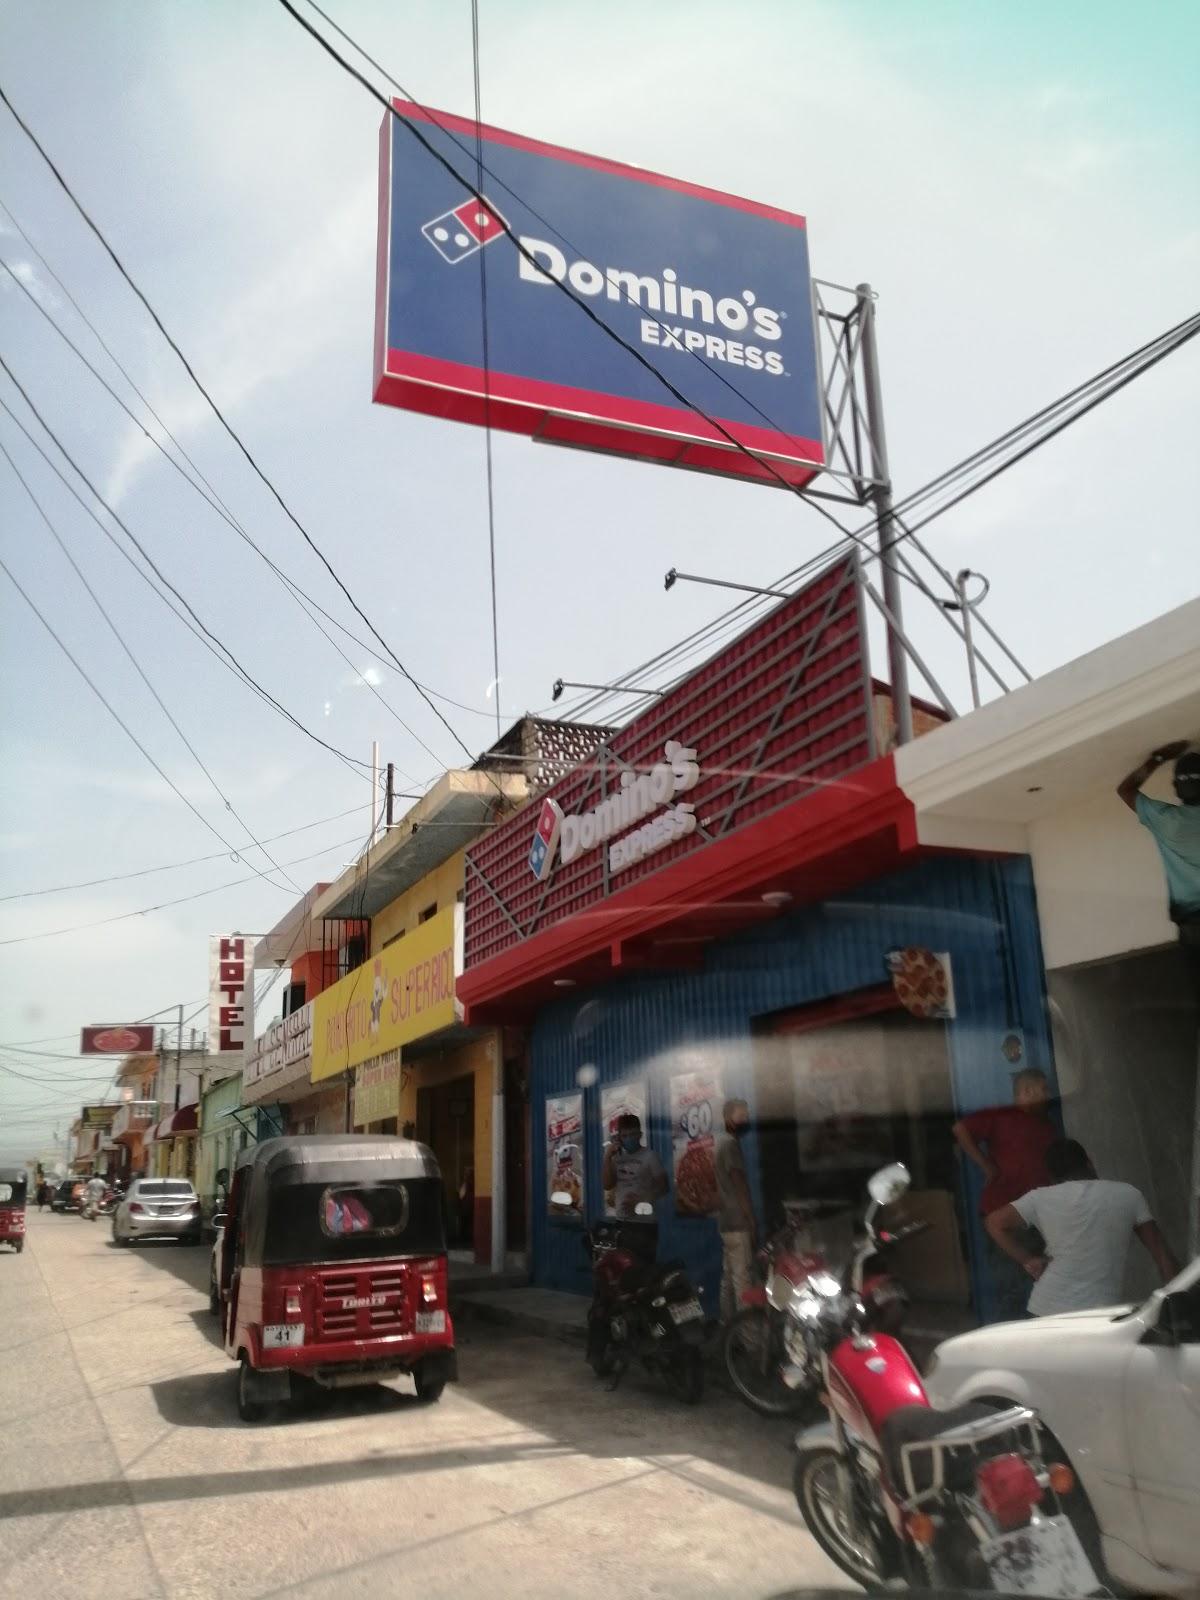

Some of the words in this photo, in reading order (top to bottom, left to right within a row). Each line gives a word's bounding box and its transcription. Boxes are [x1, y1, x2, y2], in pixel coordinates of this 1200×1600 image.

[519, 235, 782, 340] Domino's
[640, 318, 785, 376] EXPRESS
[560, 740, 700, 864] Domino's
[219, 938, 244, 1051] HOTEL
[274, 1331, 291, 1342] 41
